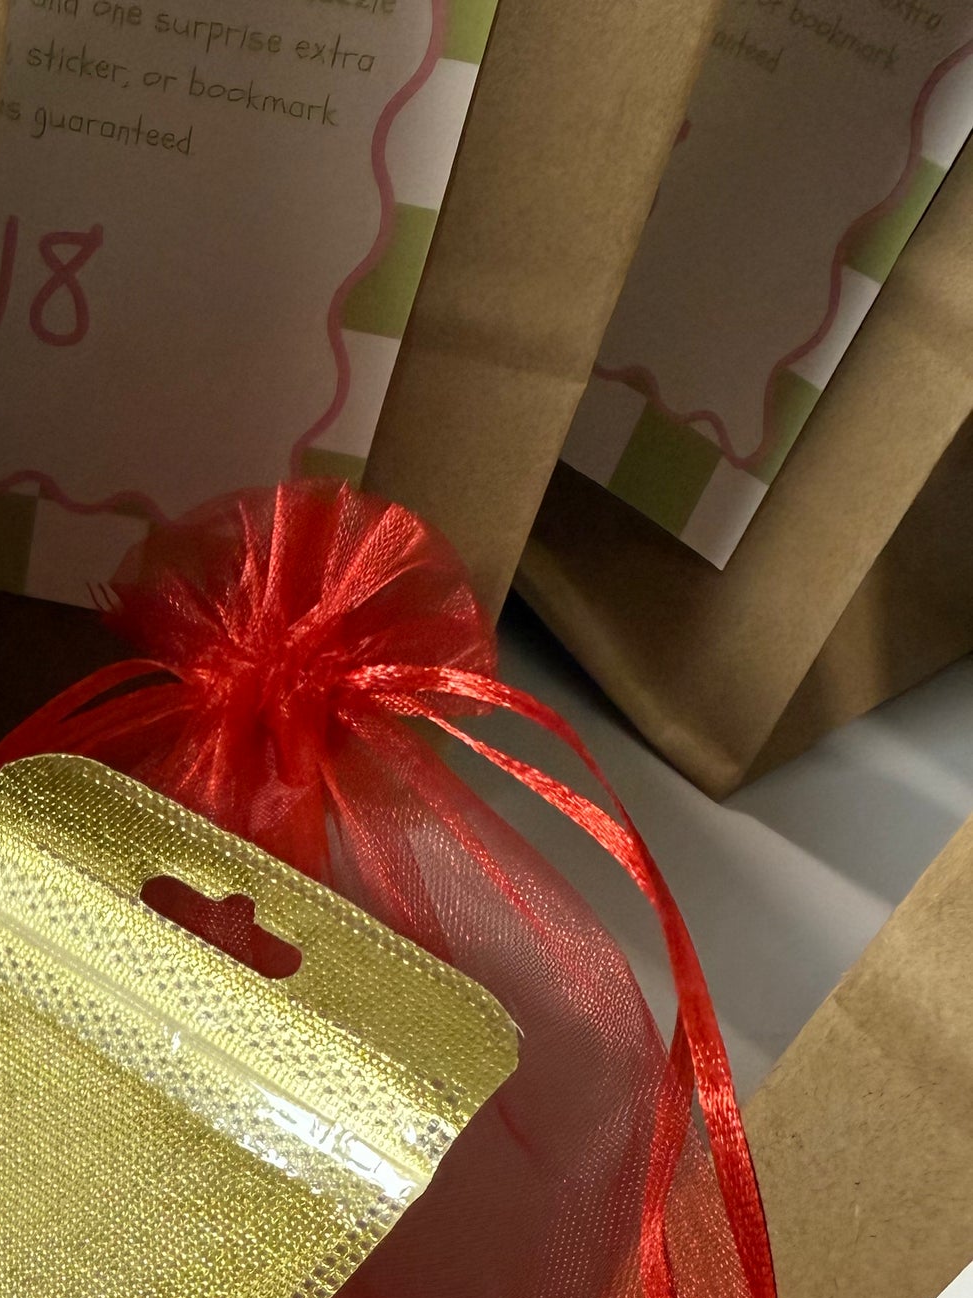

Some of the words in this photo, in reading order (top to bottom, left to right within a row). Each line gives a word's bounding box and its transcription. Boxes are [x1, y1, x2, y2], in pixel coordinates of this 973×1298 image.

[92, 0, 143, 27] one
[154, 13, 283, 53] surprise
[294, 33, 377, 73] extra
[27, 39, 130, 90] sticker,
[142, 71, 179, 92] or
[188, 66, 340, 127] bookmark
